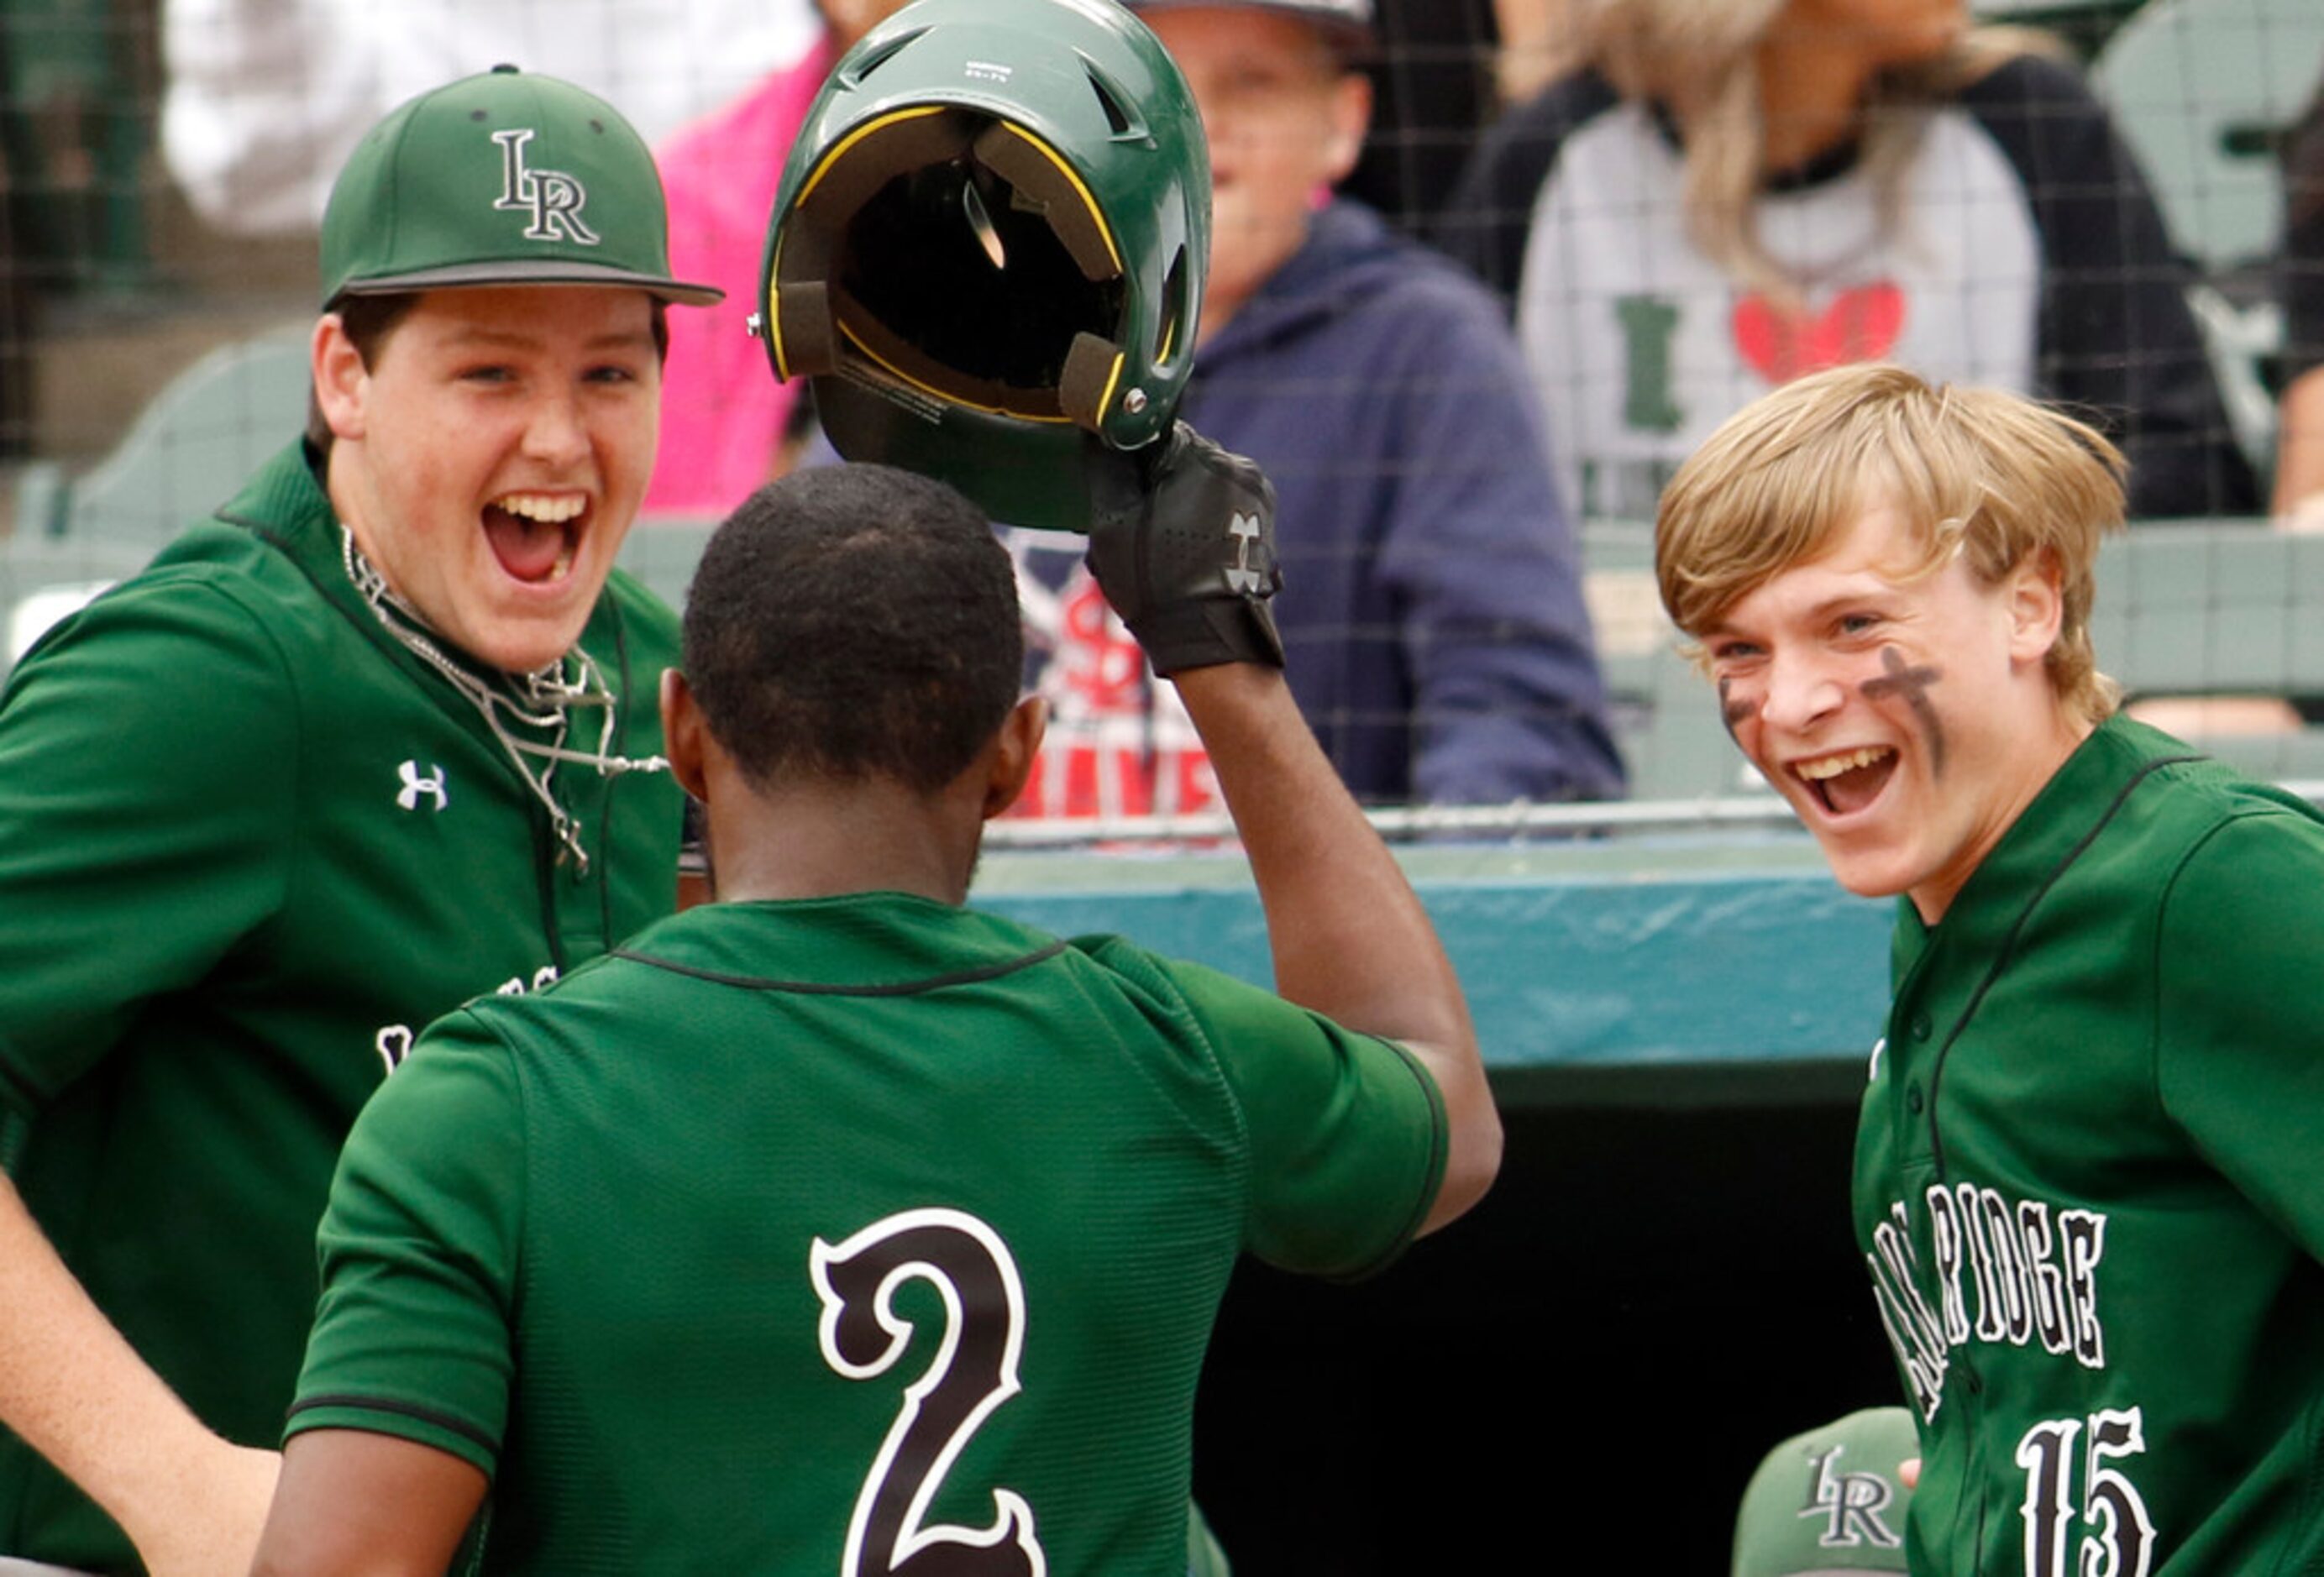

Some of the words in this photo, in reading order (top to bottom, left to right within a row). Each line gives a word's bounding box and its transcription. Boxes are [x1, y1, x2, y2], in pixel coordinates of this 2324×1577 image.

[491, 128, 601, 245] LR
[1927, 1182, 2106, 1369] RIDGE
[810, 1208, 1047, 1577] 2
[1797, 1444, 1902, 1548] LR
[2016, 1406, 2158, 1577] 15
